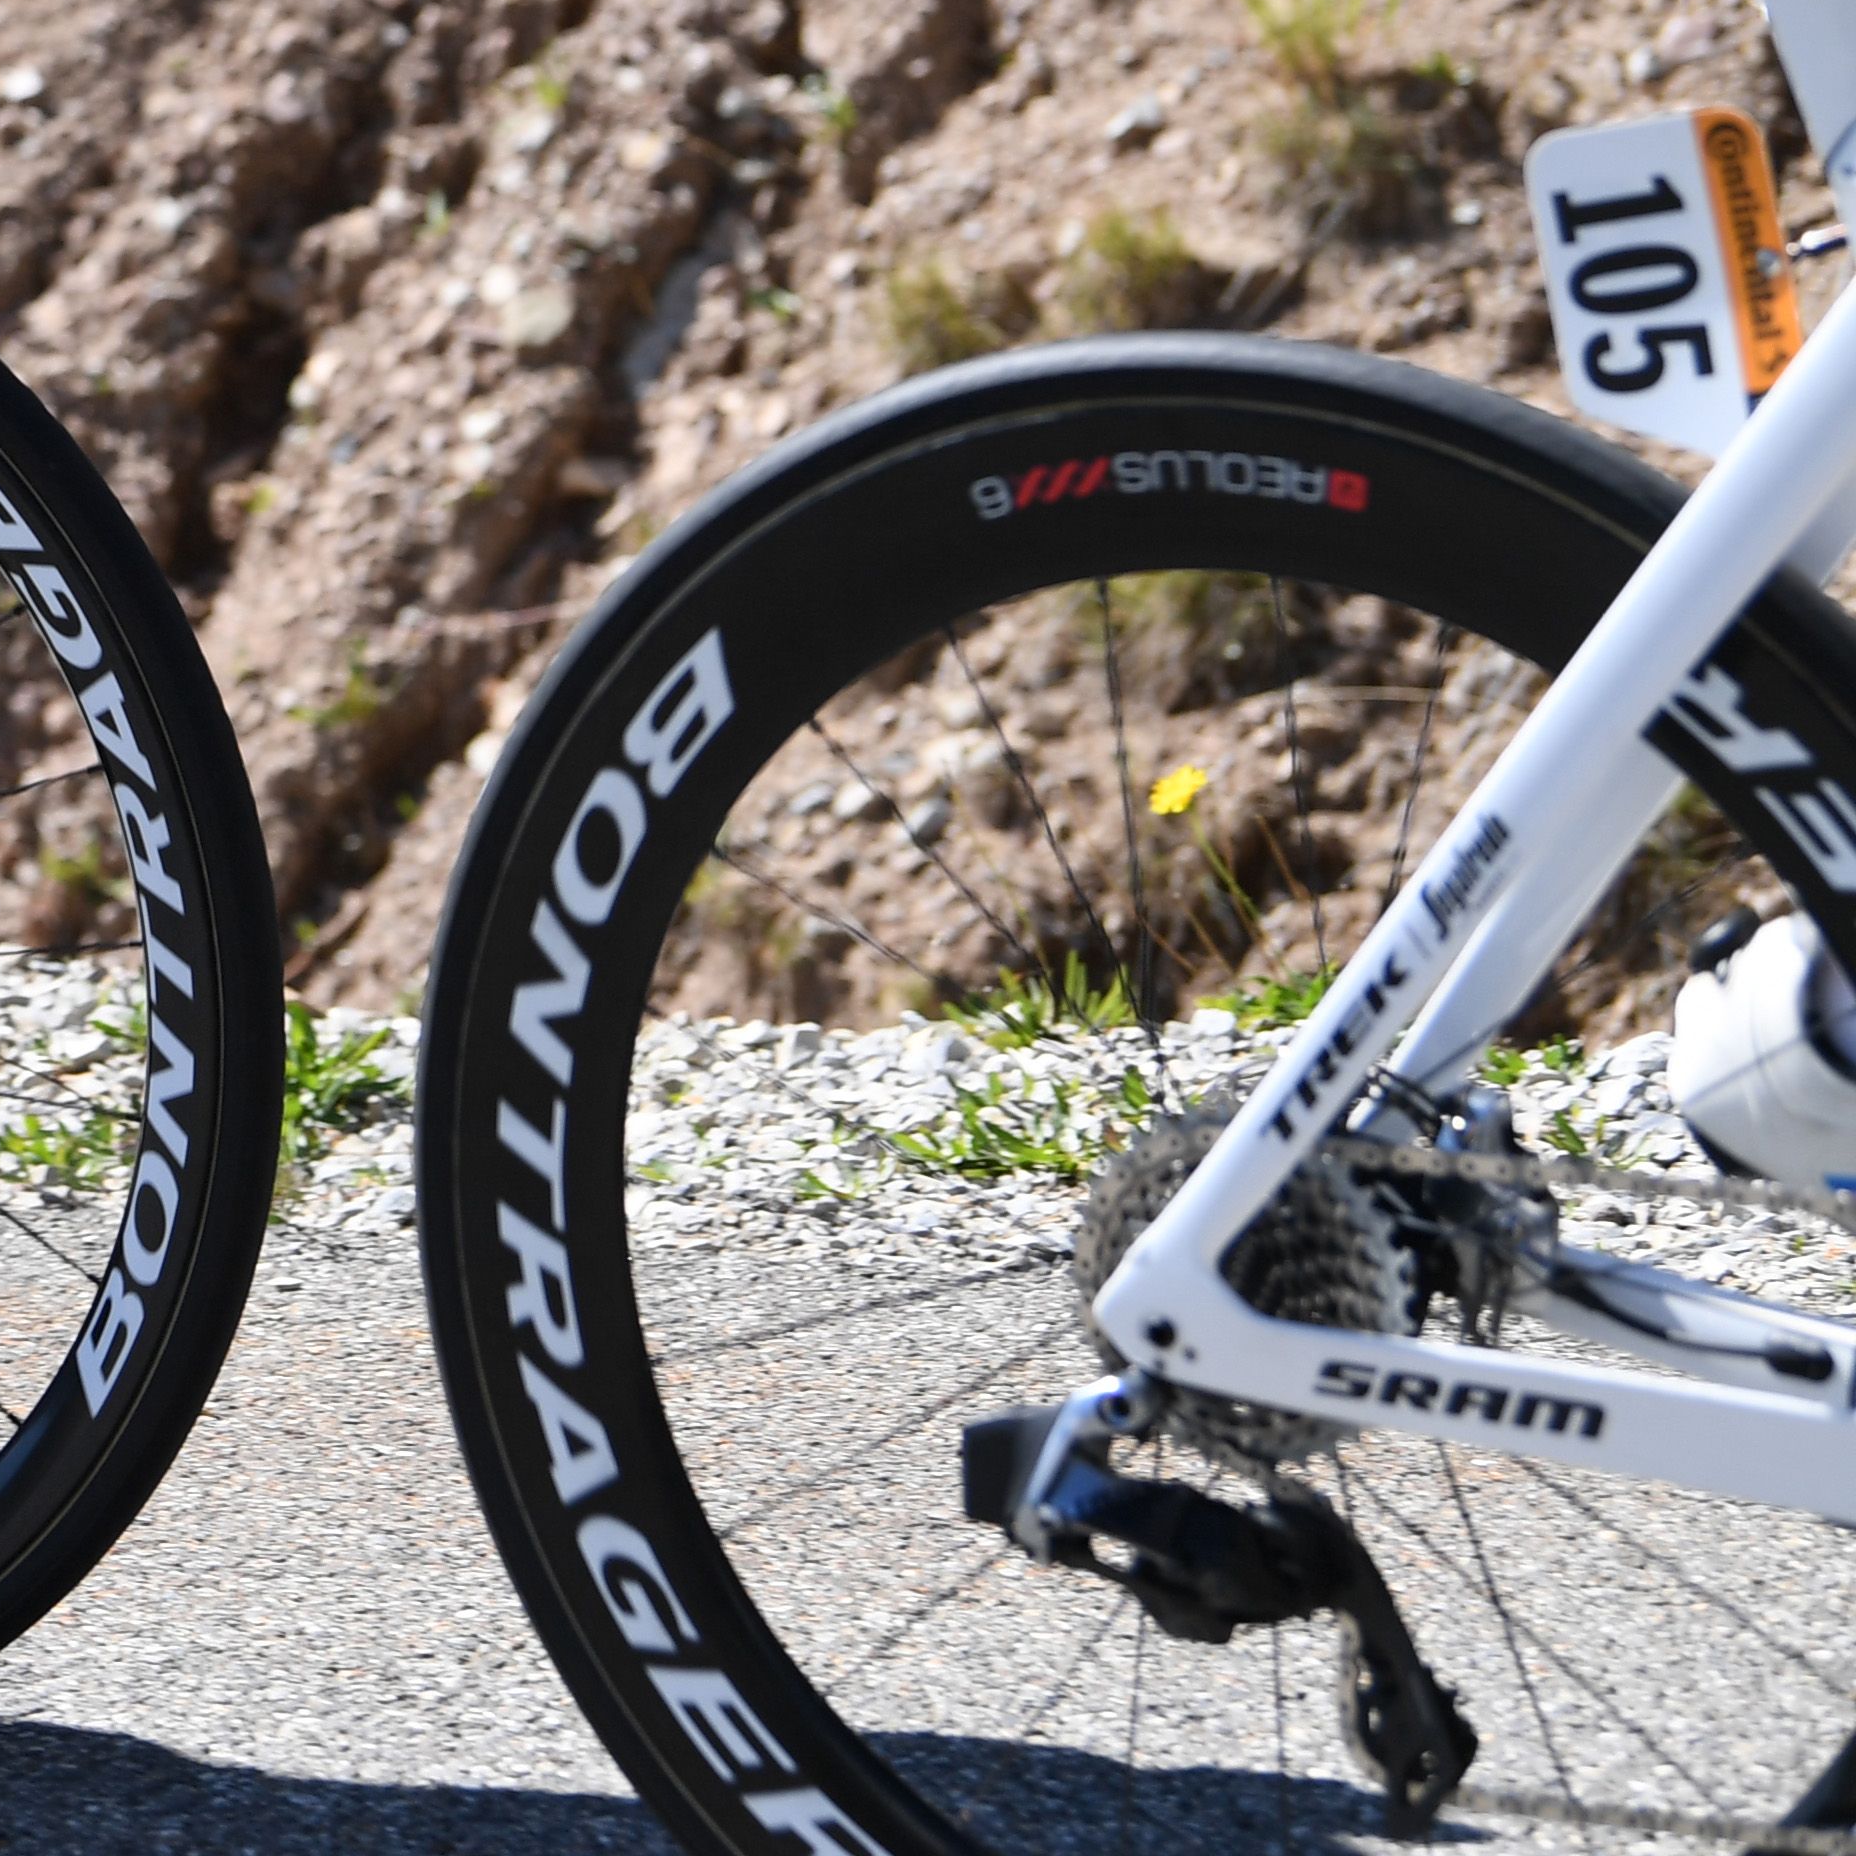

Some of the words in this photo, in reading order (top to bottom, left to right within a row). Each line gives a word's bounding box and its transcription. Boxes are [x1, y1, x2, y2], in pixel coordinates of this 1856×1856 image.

[1552, 174, 1714, 394] 105
[1104, 450, 1327, 505] AEOLUS
[1260, 952, 1408, 1141] TREK
[1314, 1360, 1607, 1440] SRAM
